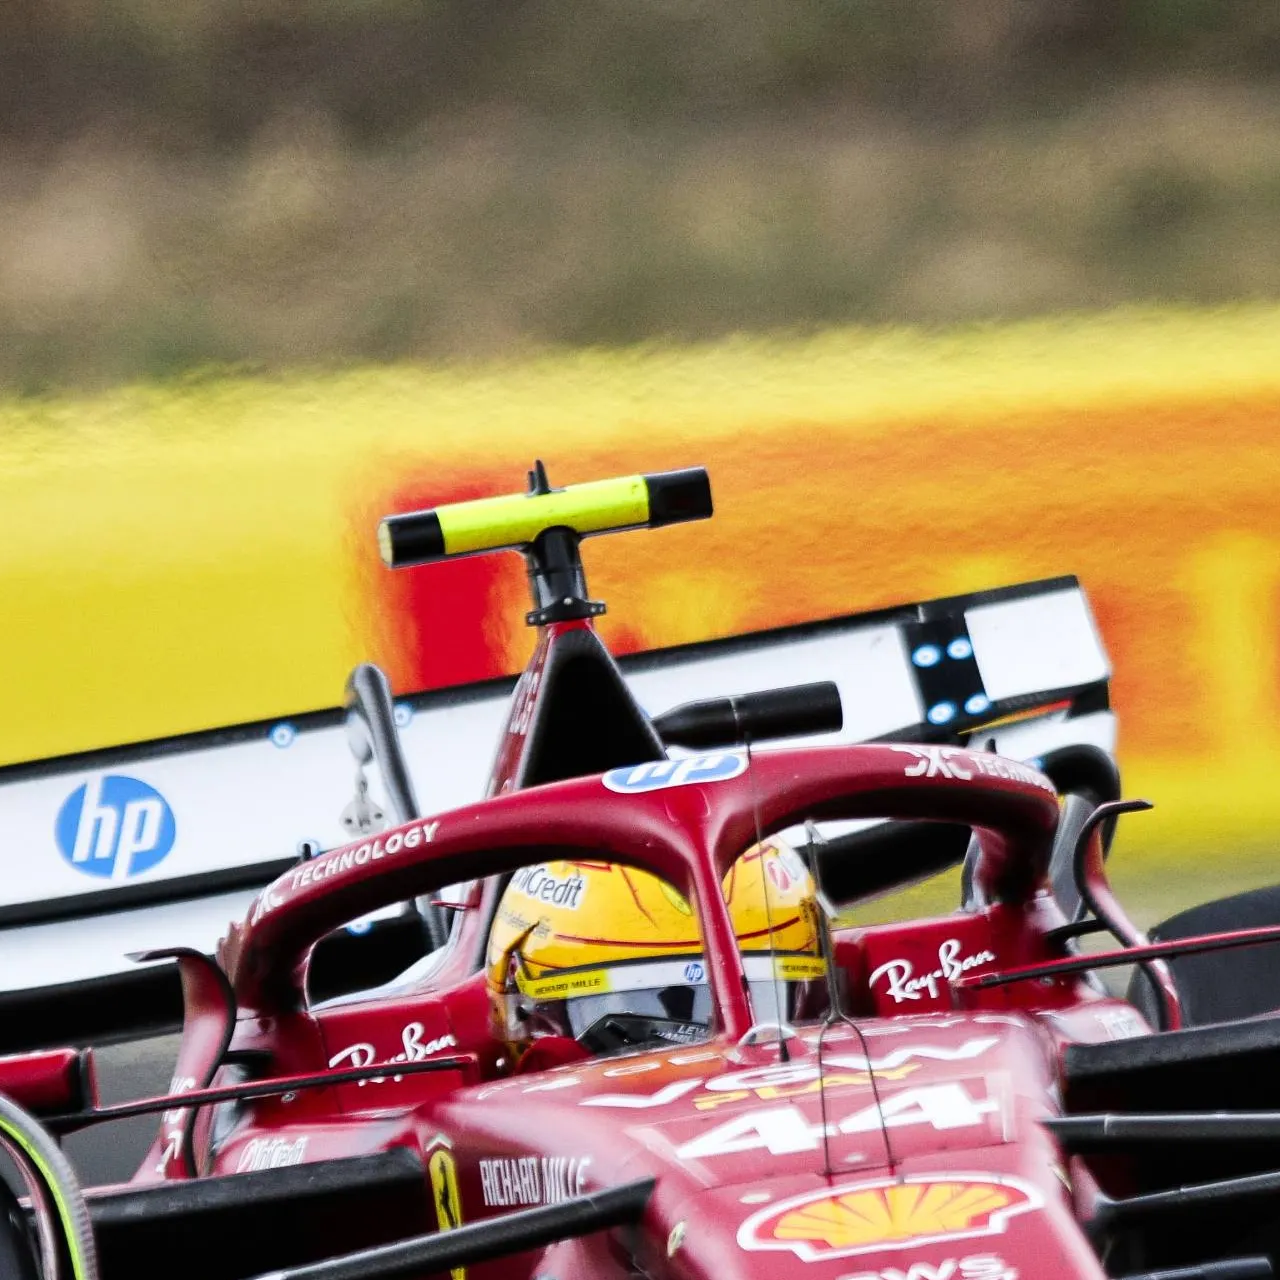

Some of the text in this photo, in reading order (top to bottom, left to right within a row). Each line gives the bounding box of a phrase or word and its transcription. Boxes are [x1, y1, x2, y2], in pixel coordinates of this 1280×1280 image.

[62, 774, 171, 881] hp
[291, 820, 441, 890] TECHNOLOGY
[685, 963, 704, 982] hp
[869, 938, 997, 1003] Ray-Ban
[675, 1081, 999, 1160] 44
[479, 1157, 540, 1206] RICHARD
